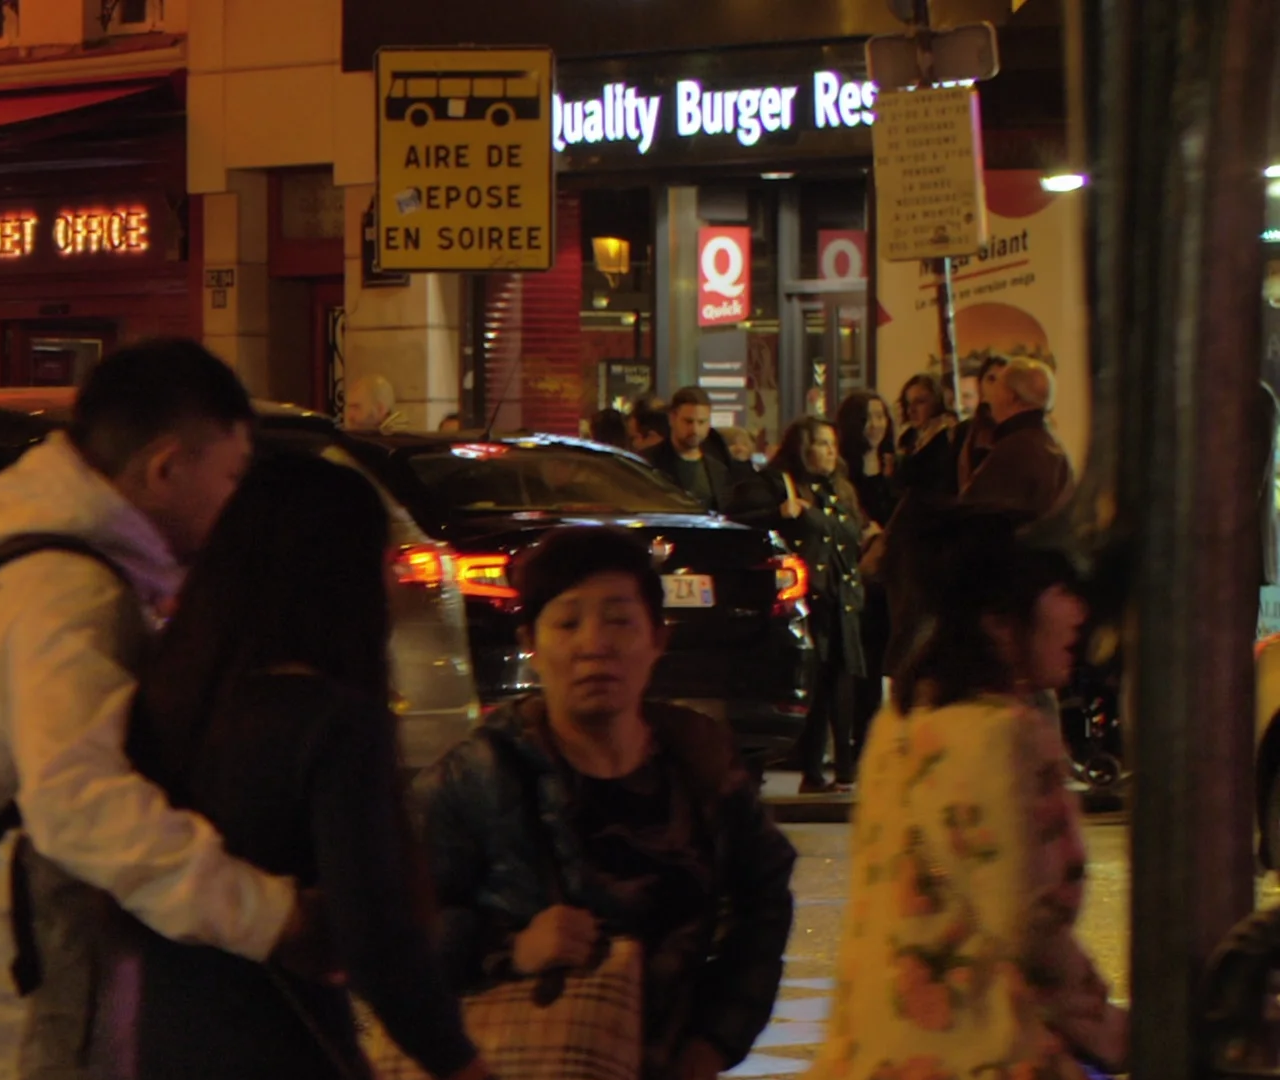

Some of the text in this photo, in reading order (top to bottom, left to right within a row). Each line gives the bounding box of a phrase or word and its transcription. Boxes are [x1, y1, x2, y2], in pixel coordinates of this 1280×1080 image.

[676, 79, 797, 146] Burger
[813, 71, 878, 128] Res
[404, 145, 522, 169] AIRE DE
[53, 205, 149, 255] OFFICE
[385, 226, 542, 250] EN SOIREE
[701, 236, 744, 297] Q
[702, 301, 743, 319] Quick
